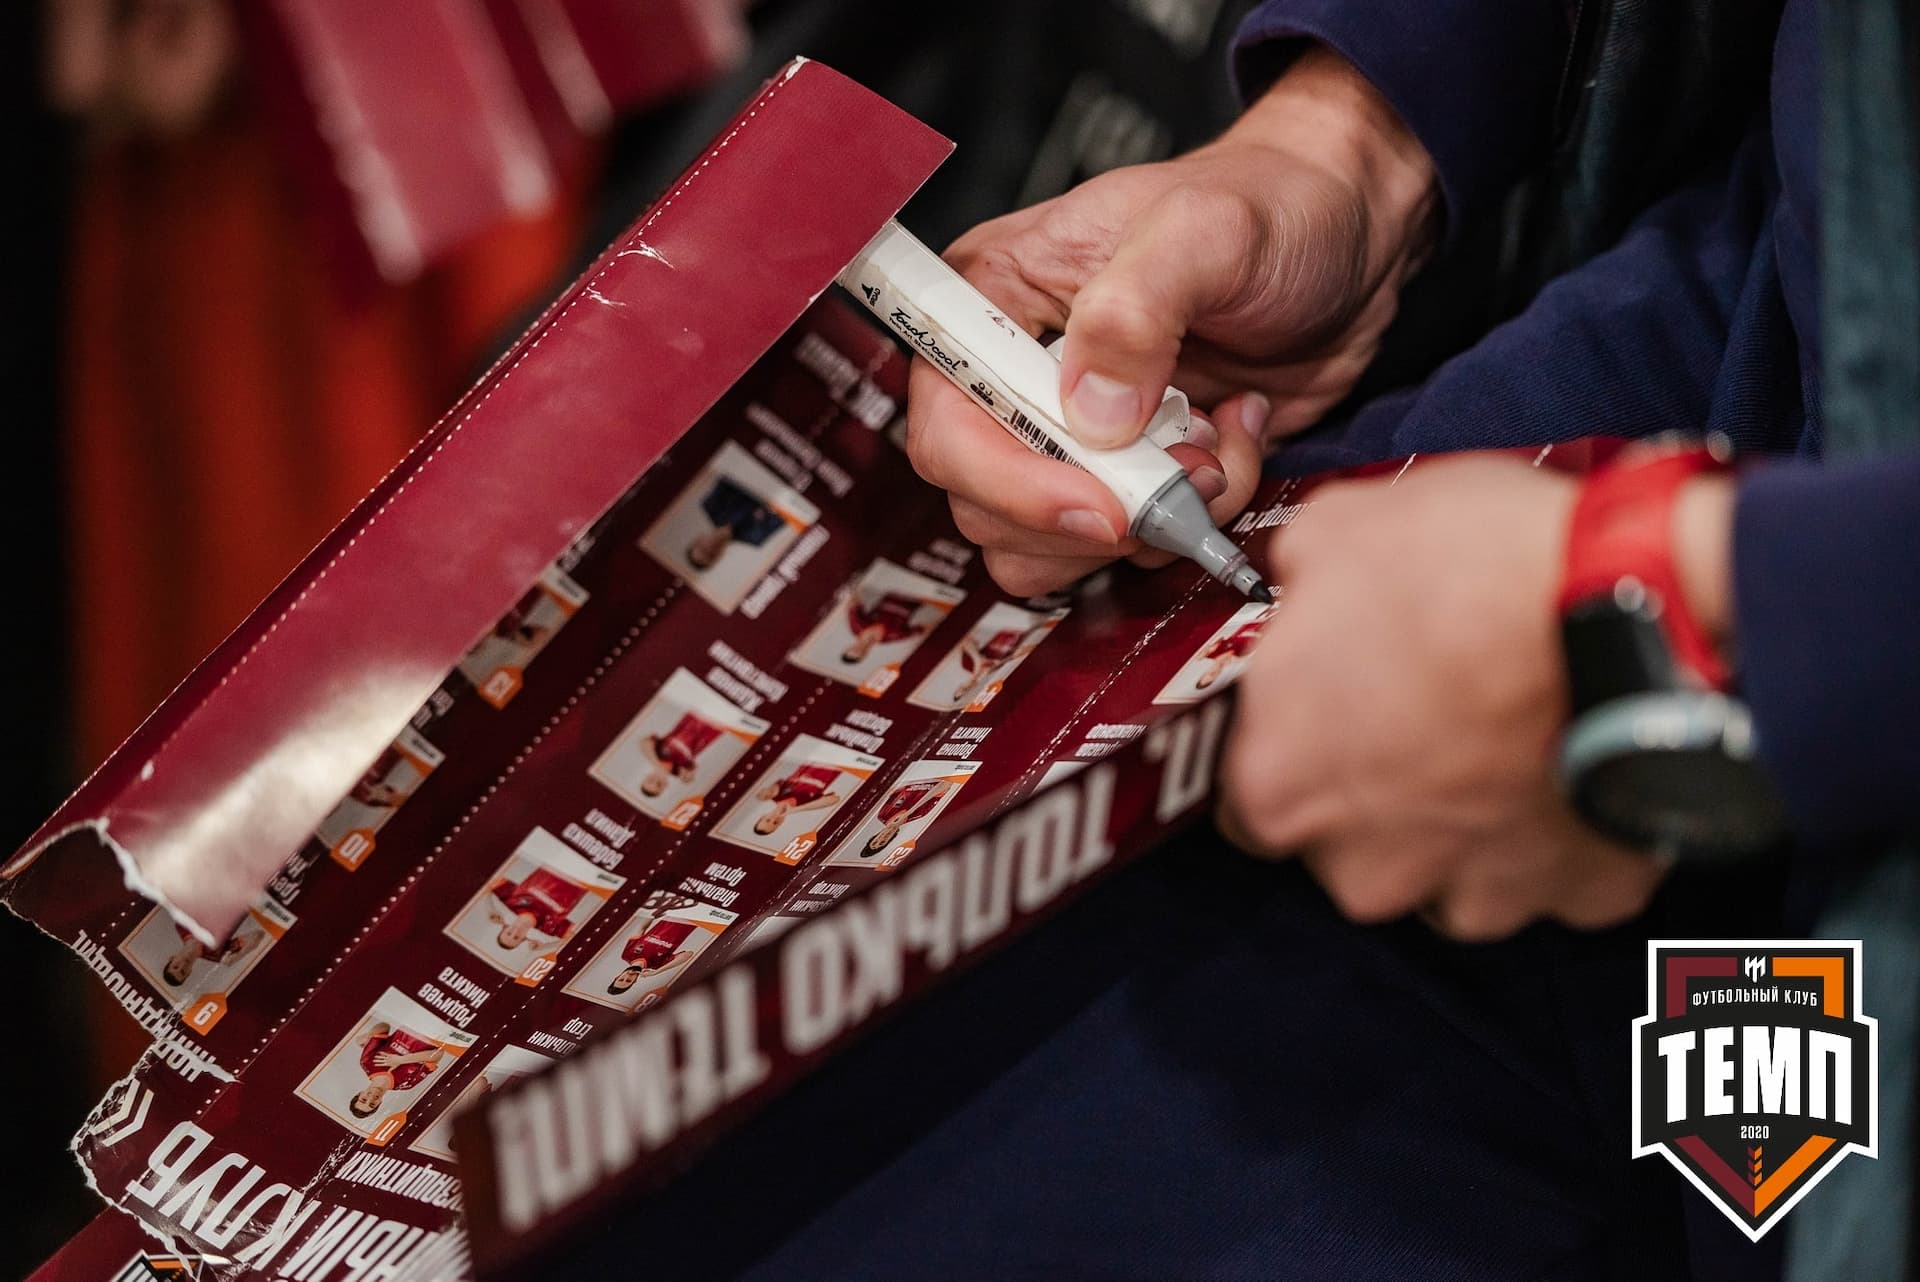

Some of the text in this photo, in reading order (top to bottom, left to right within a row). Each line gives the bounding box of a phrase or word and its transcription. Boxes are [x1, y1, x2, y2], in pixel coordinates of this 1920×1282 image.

[952, 726, 993, 743] Никита
[340, 833, 365, 859] 10
[784, 837, 811, 861] 24
[706, 862, 748, 886] Артём
[780, 769, 1115, 1054] ТОЛЬКО
[523, 957, 555, 981] 20
[438, 967, 490, 1006] Никита
[193, 1002, 217, 1026] 9
[417, 982, 476, 1028] Родичев
[563, 1016, 595, 1042] Егор
[494, 965, 771, 1232] ТЕМП!
[373, 1119, 400, 1142] 11
[126, 1119, 308, 1271] КЛУБ
